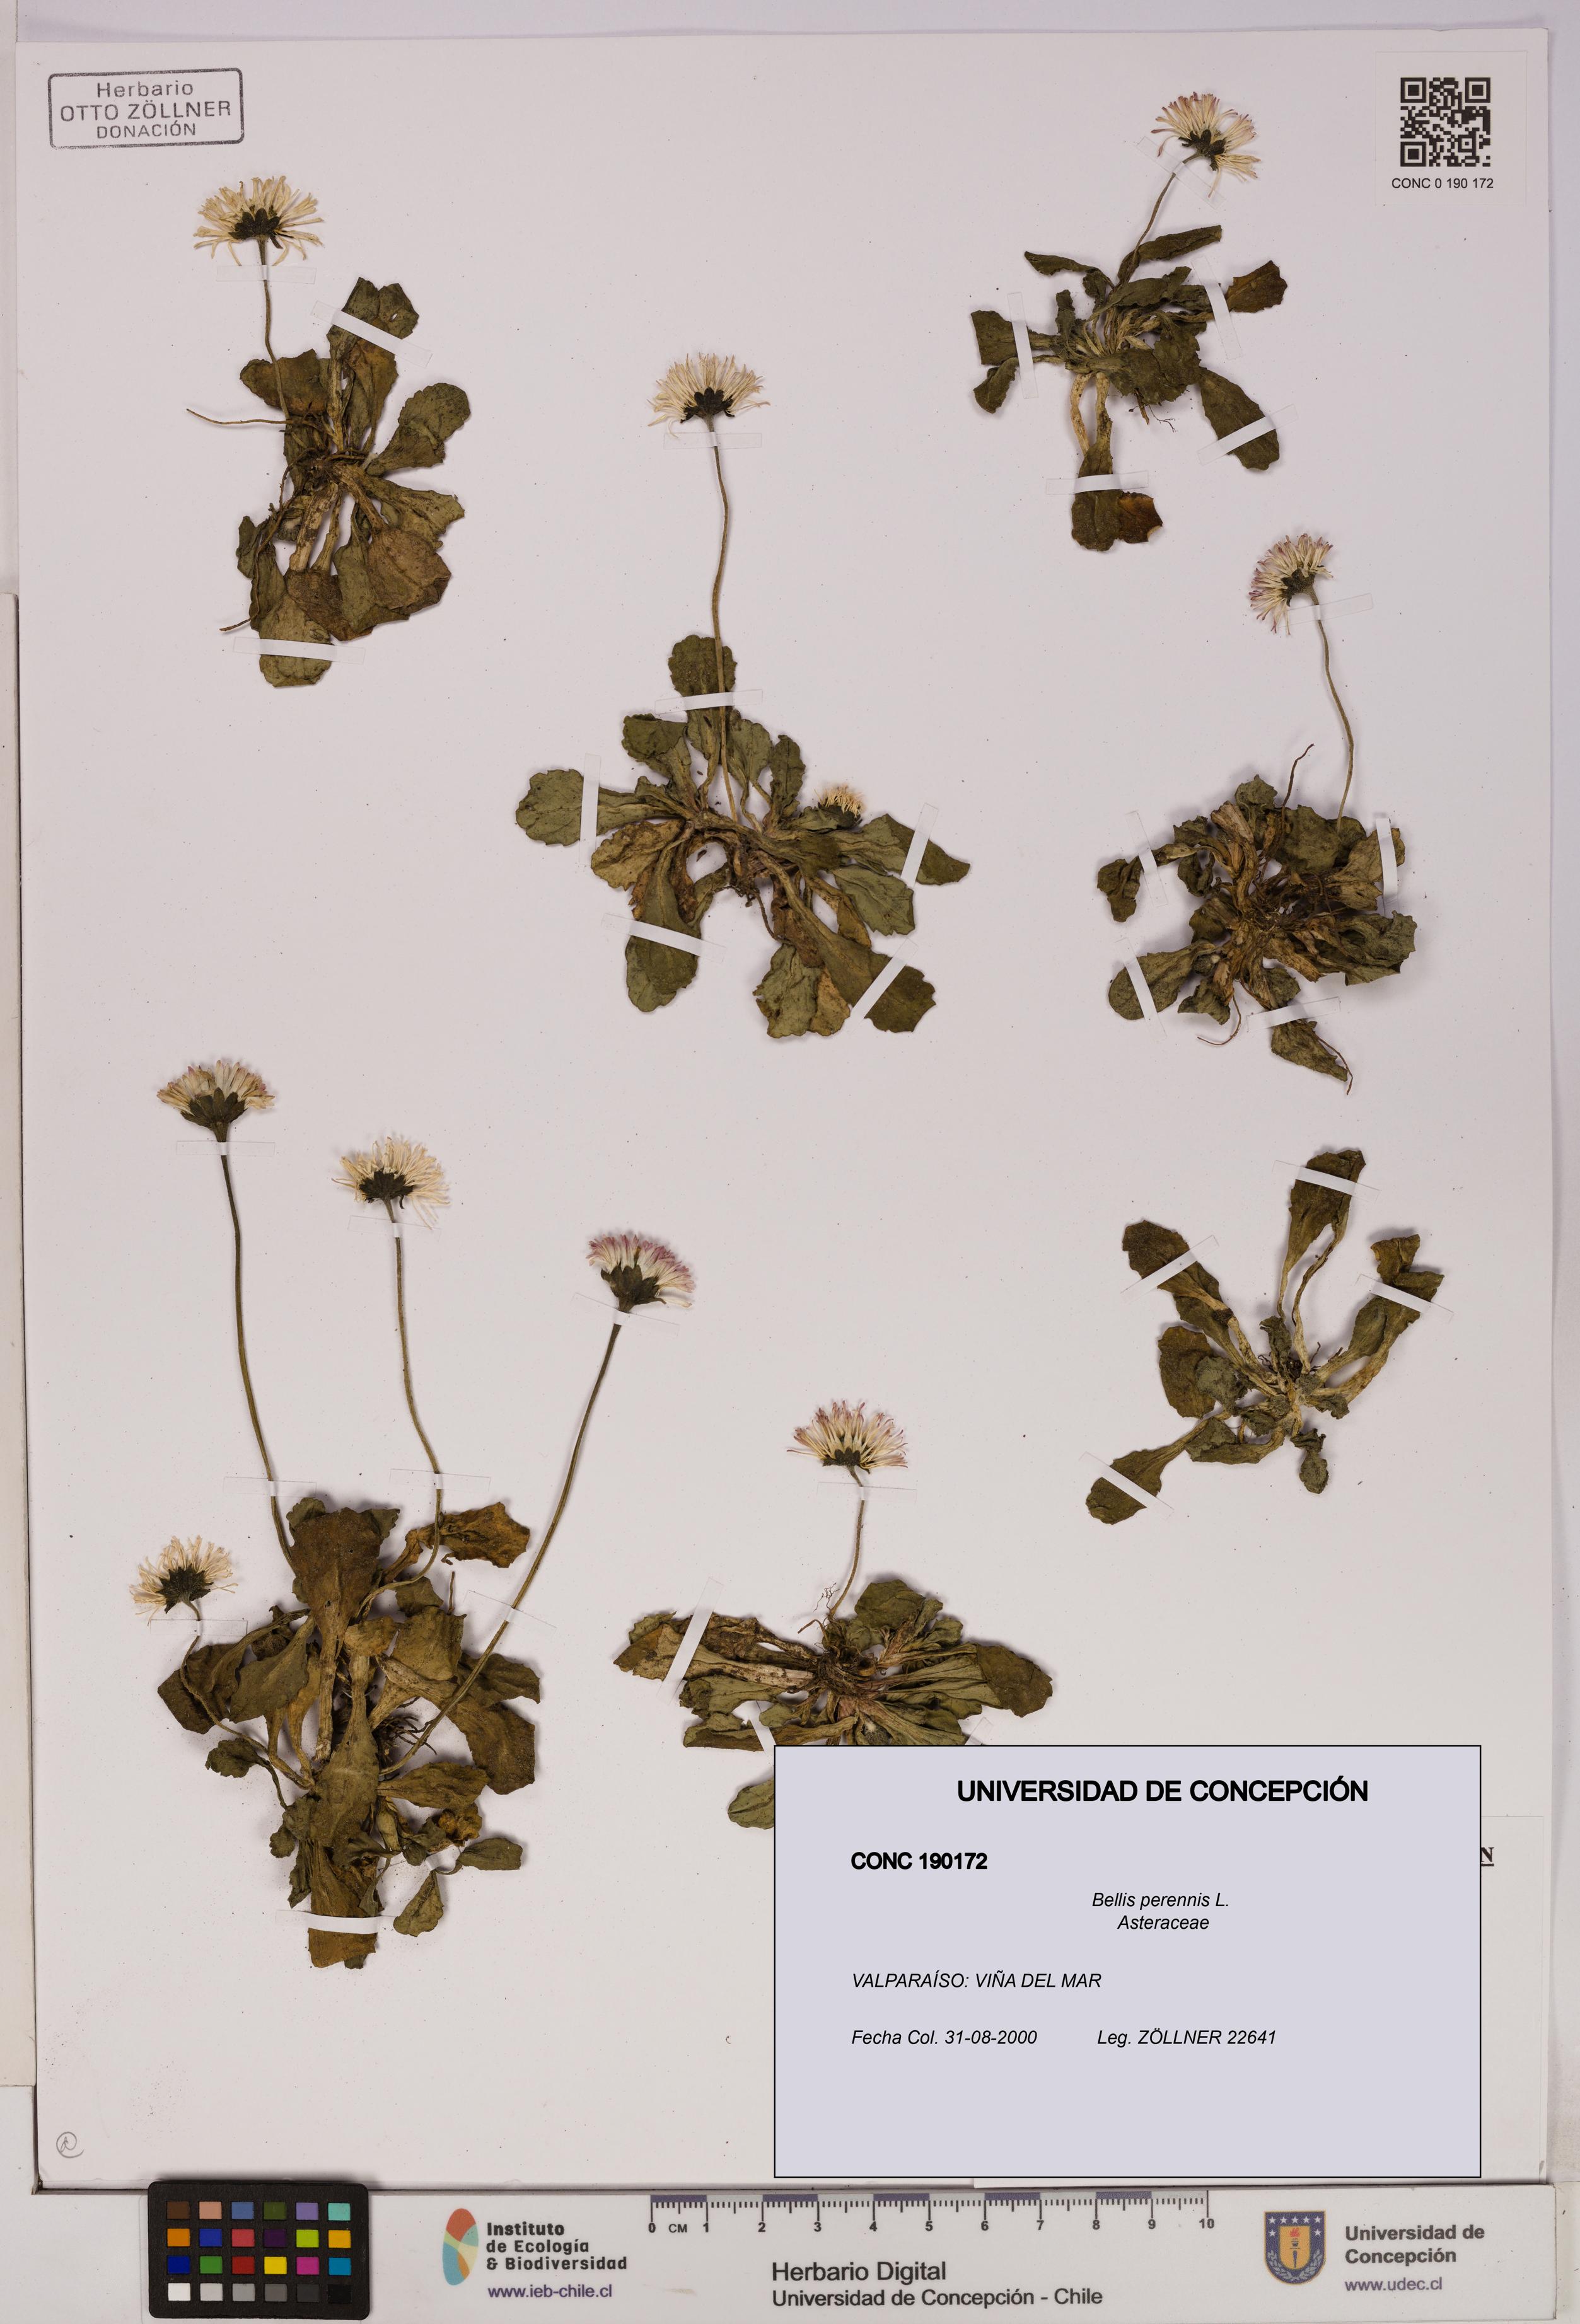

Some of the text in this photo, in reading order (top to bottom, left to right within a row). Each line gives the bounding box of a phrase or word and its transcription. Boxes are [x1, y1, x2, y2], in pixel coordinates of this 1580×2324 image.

[96, 79, 194, 98] Herbario
[60, 99, 231, 121] OTTO ZÖLLNER
[96, 120, 196, 139] DONACIÓN
[1391, 177, 1494, 189] CONC 0 190 172
[487, 2221, 565, 2236] Instituto
[648, 2218, 1215, 2233] 0 CM 1 2 3 4 5 6 7 8 9 10
[1345, 2224, 1485, 2241] Universidad de
[485, 2238, 589, 2255] de Ecología
[486, 2256, 627, 2270] & Biodiversidad
[1344, 2247, 1456, 2267] Concepción
[772, 2261, 946, 2286] Herbario Digital
[487, 2284, 612, 2298] www.ieb-chile.cl
[1344, 2276, 1443, 2292] www.udec.cl
[772, 2289, 885, 2307] Universidad
[891, 2289, 915, 2306] de
[921, 2288, 1035, 2310] Concepción
[1054, 2287, 1103, 2305] Chile
